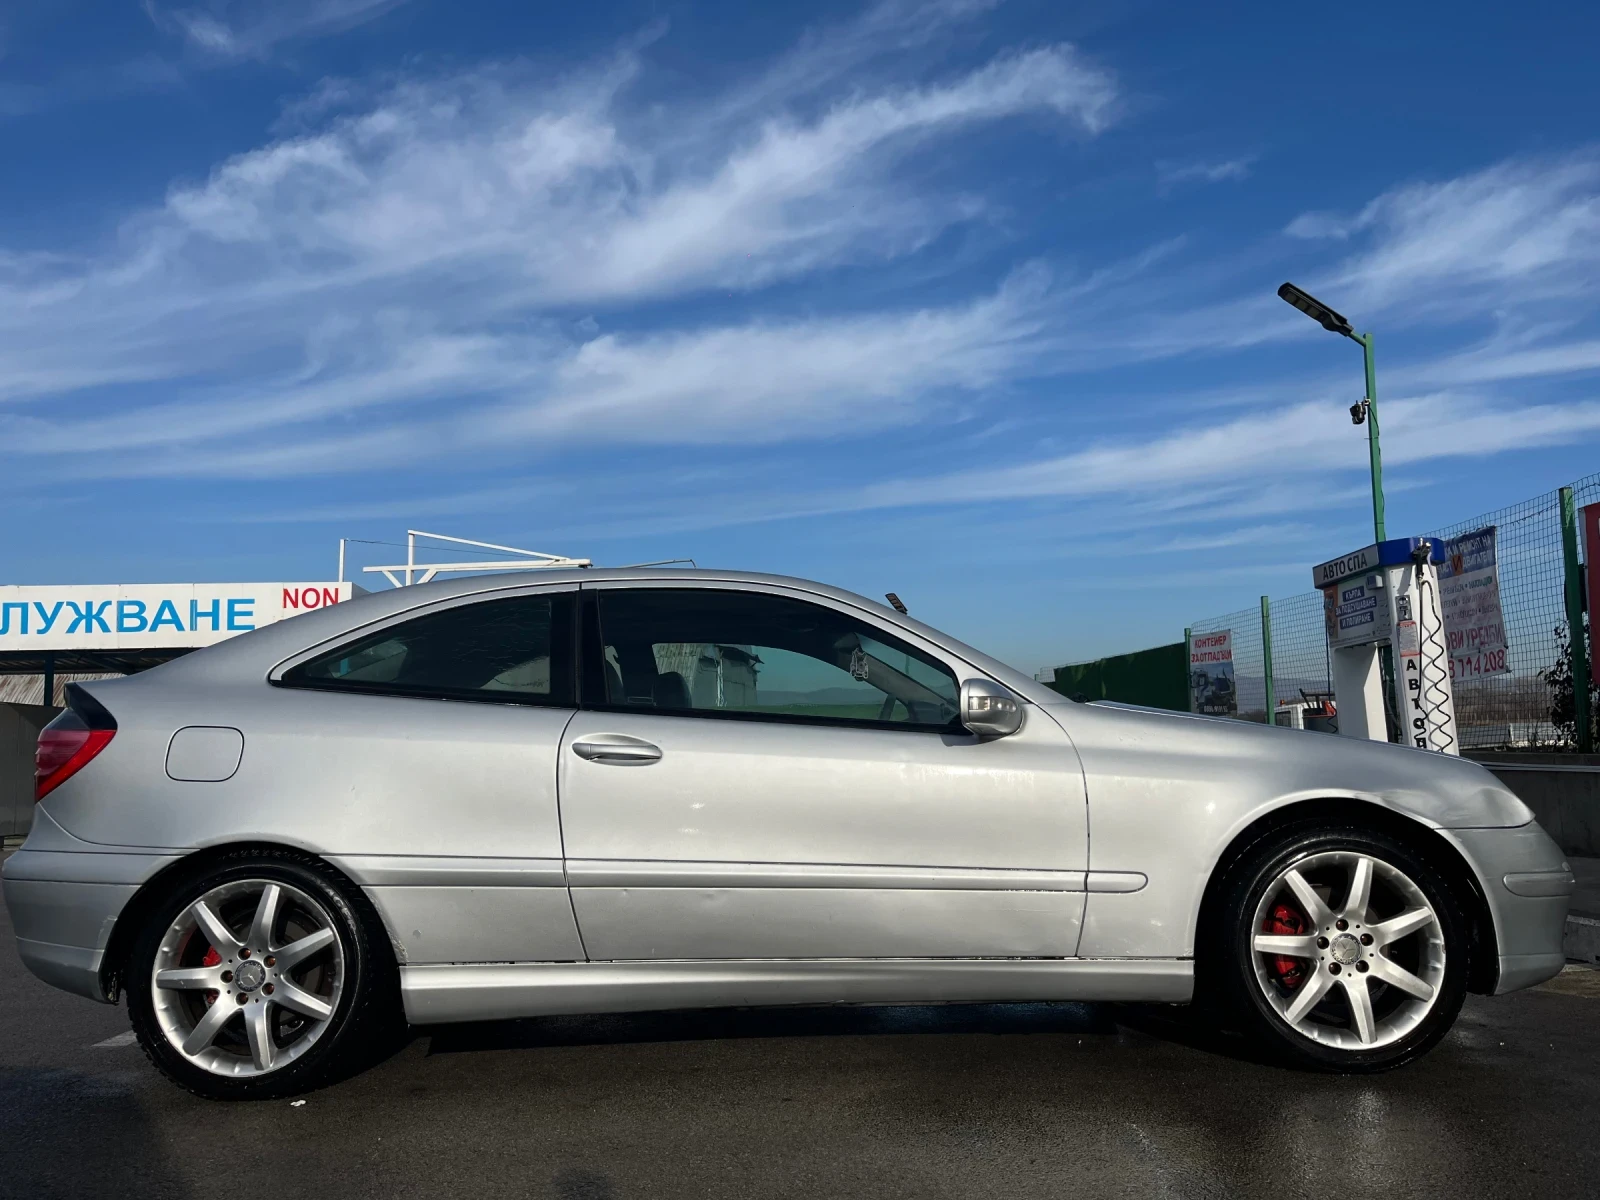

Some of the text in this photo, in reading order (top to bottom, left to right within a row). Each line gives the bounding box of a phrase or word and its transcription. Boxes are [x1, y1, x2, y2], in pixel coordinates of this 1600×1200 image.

[1323, 553, 1368, 580] АВТО СПА
[283, 587, 339, 609] NON
[0, 598, 256, 636] ЛУЖВАНЕ
[1483, 649, 1505, 673] 208
